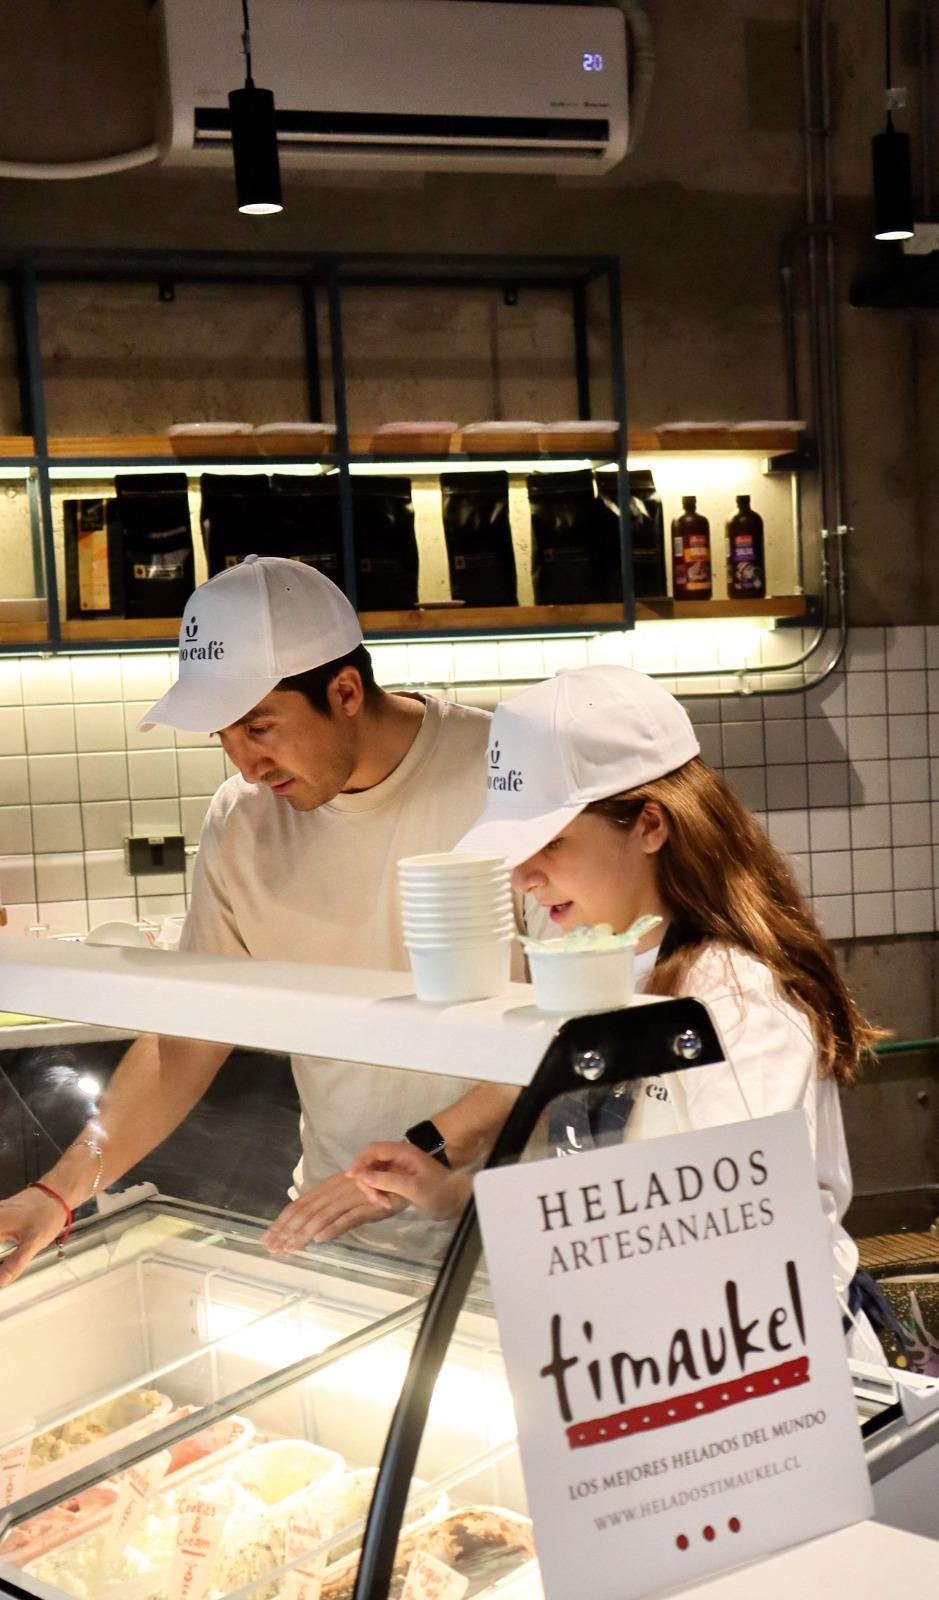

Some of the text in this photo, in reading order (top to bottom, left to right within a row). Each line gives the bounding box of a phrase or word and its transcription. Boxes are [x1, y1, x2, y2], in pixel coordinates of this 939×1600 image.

[583, 53, 603, 71] 20
[645, 1083, 670, 1103] ca
[537, 1150, 768, 1232] HELADOS
[548, 1198, 775, 1276] ARTESANALES
[540, 1260, 807, 1423] timaukel
[568, 1410, 827, 1501] LOS MEJORES HELADOS DEL MUNDO
[593, 1456, 801, 1531] WWW.HELADOSTIMAUKEL.CL
